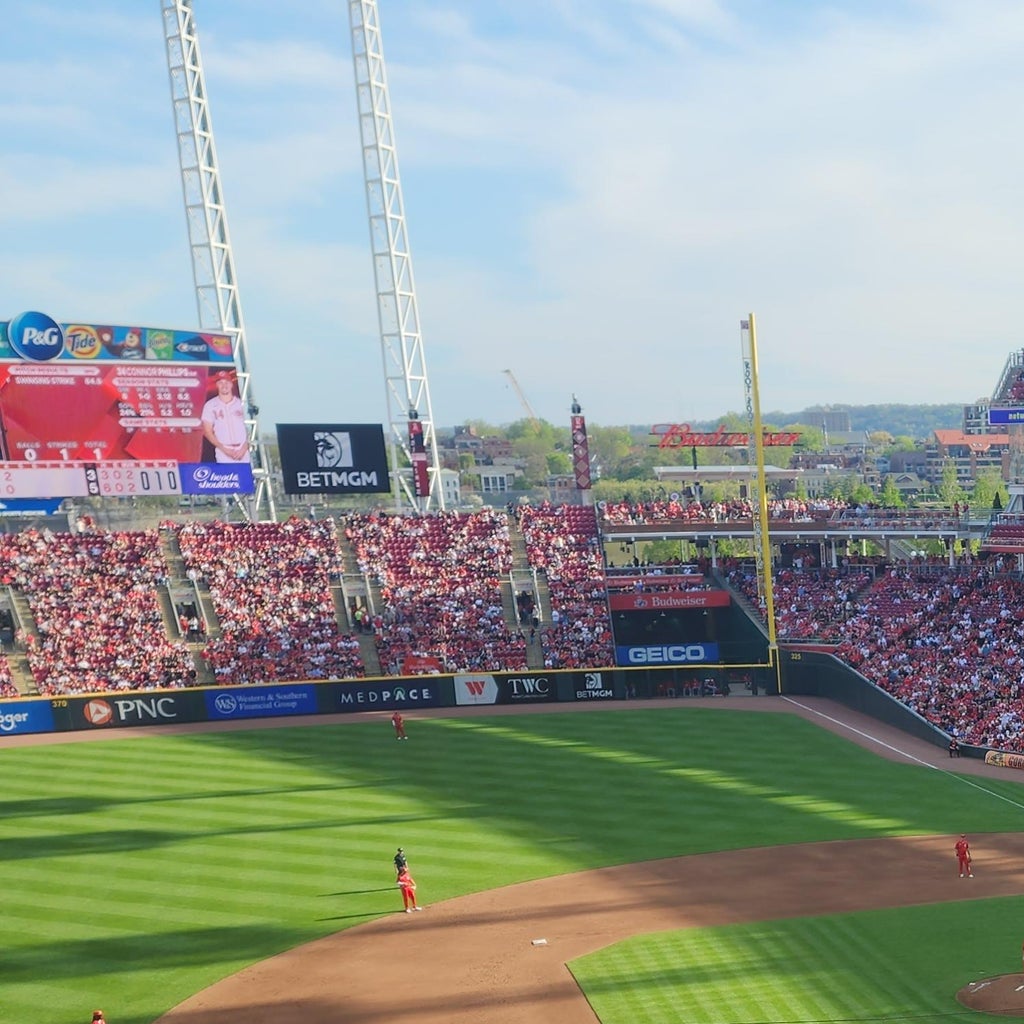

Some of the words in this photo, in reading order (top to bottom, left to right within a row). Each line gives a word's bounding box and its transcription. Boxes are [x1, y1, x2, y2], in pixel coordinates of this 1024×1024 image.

[22, 327, 59, 346] P&G
[68, 333, 96, 352] Tide
[158, 367, 188, 377] PHILLIPS
[24, 448, 37, 461] 0
[60, 448, 69, 461] 1
[93, 448, 102, 461] 1
[86, 469, 97, 481] 3
[113, 471, 121, 480] 0
[127, 471, 134, 480] 2
[140, 471, 150, 491] 0
[155, 471, 162, 490] 1
[168, 471, 177, 490] 0
[297, 471, 378, 488] BETMGM
[6, 485, 14, 494] 0
[88, 482, 99, 494] 5
[115, 483, 123, 492] 0
[128, 483, 136, 493] 2
[652, 596, 706, 608] Budweiser
[628, 645, 706, 663] GEICO
[464, 681, 486, 695] W
[508, 677, 549, 694] TWC
[236, 695, 266, 703] Western
[275, 692, 308, 700] Southern
[341, 688, 430, 703] MEDPACE
[577, 690, 613, 699] BETMGM
[115, 697, 177, 720] PNC
[239, 701, 272, 710] Financial
